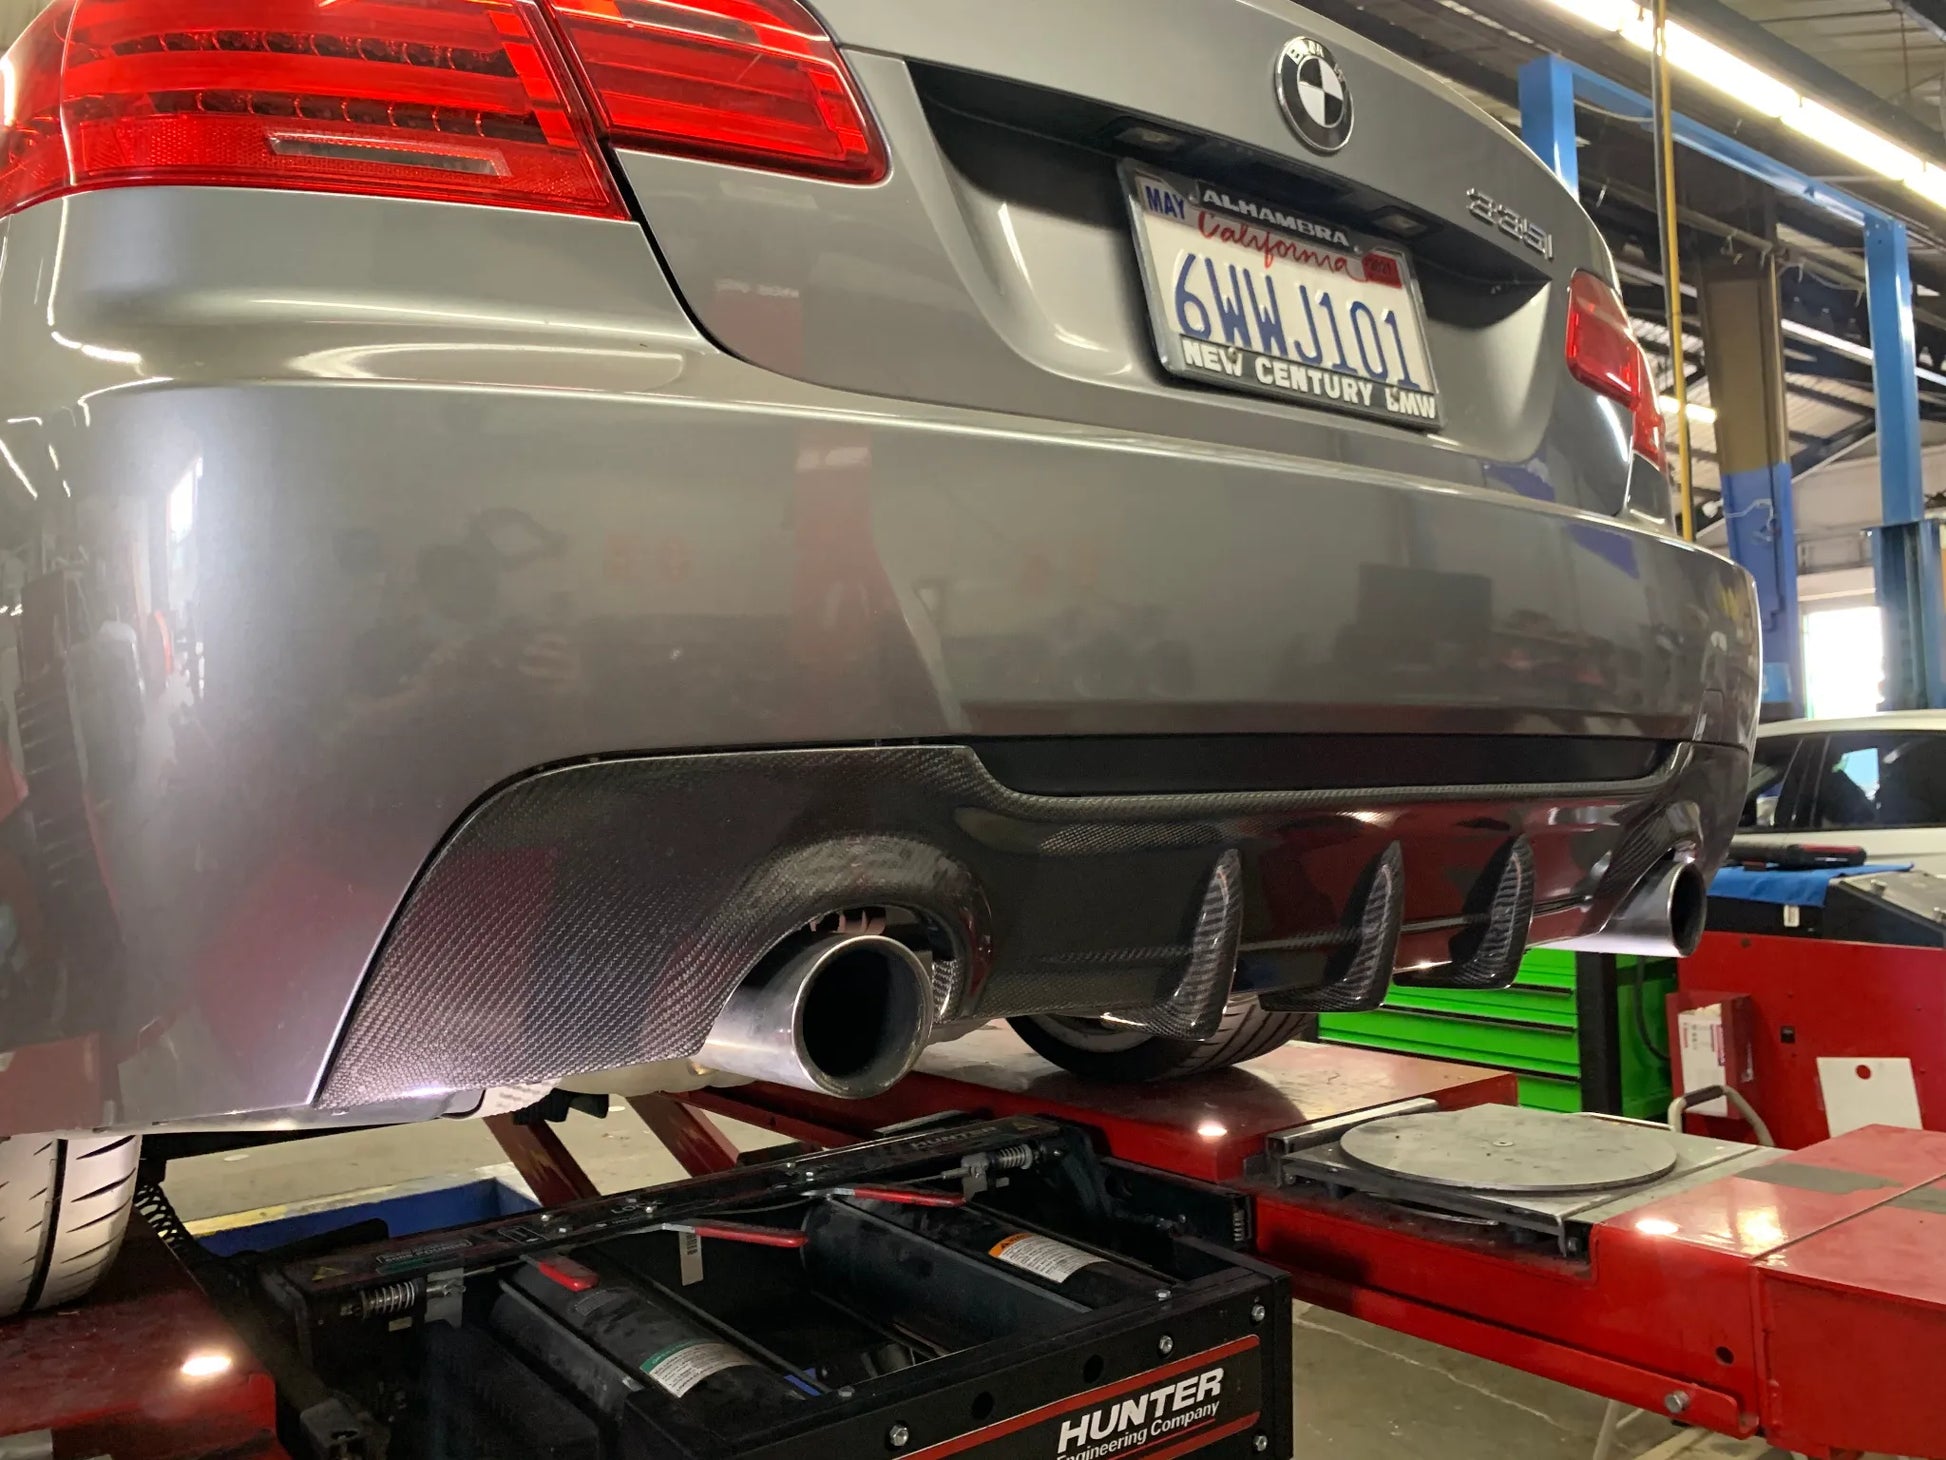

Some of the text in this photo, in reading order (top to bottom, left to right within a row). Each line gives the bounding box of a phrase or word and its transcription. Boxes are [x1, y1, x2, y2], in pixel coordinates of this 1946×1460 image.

[1145, 185, 1185, 220] MAY
[1203, 189, 1350, 247] ALHAMBRA
[1198, 210, 1362, 282] California
[1174, 253, 1420, 390] 6WWJ101
[1182, 340, 1243, 377] NEW
[1255, 358, 1373, 407] CENTURY
[1057, 1367, 1224, 1454] HUNTER
[1151, 1401, 1220, 1436] Company
